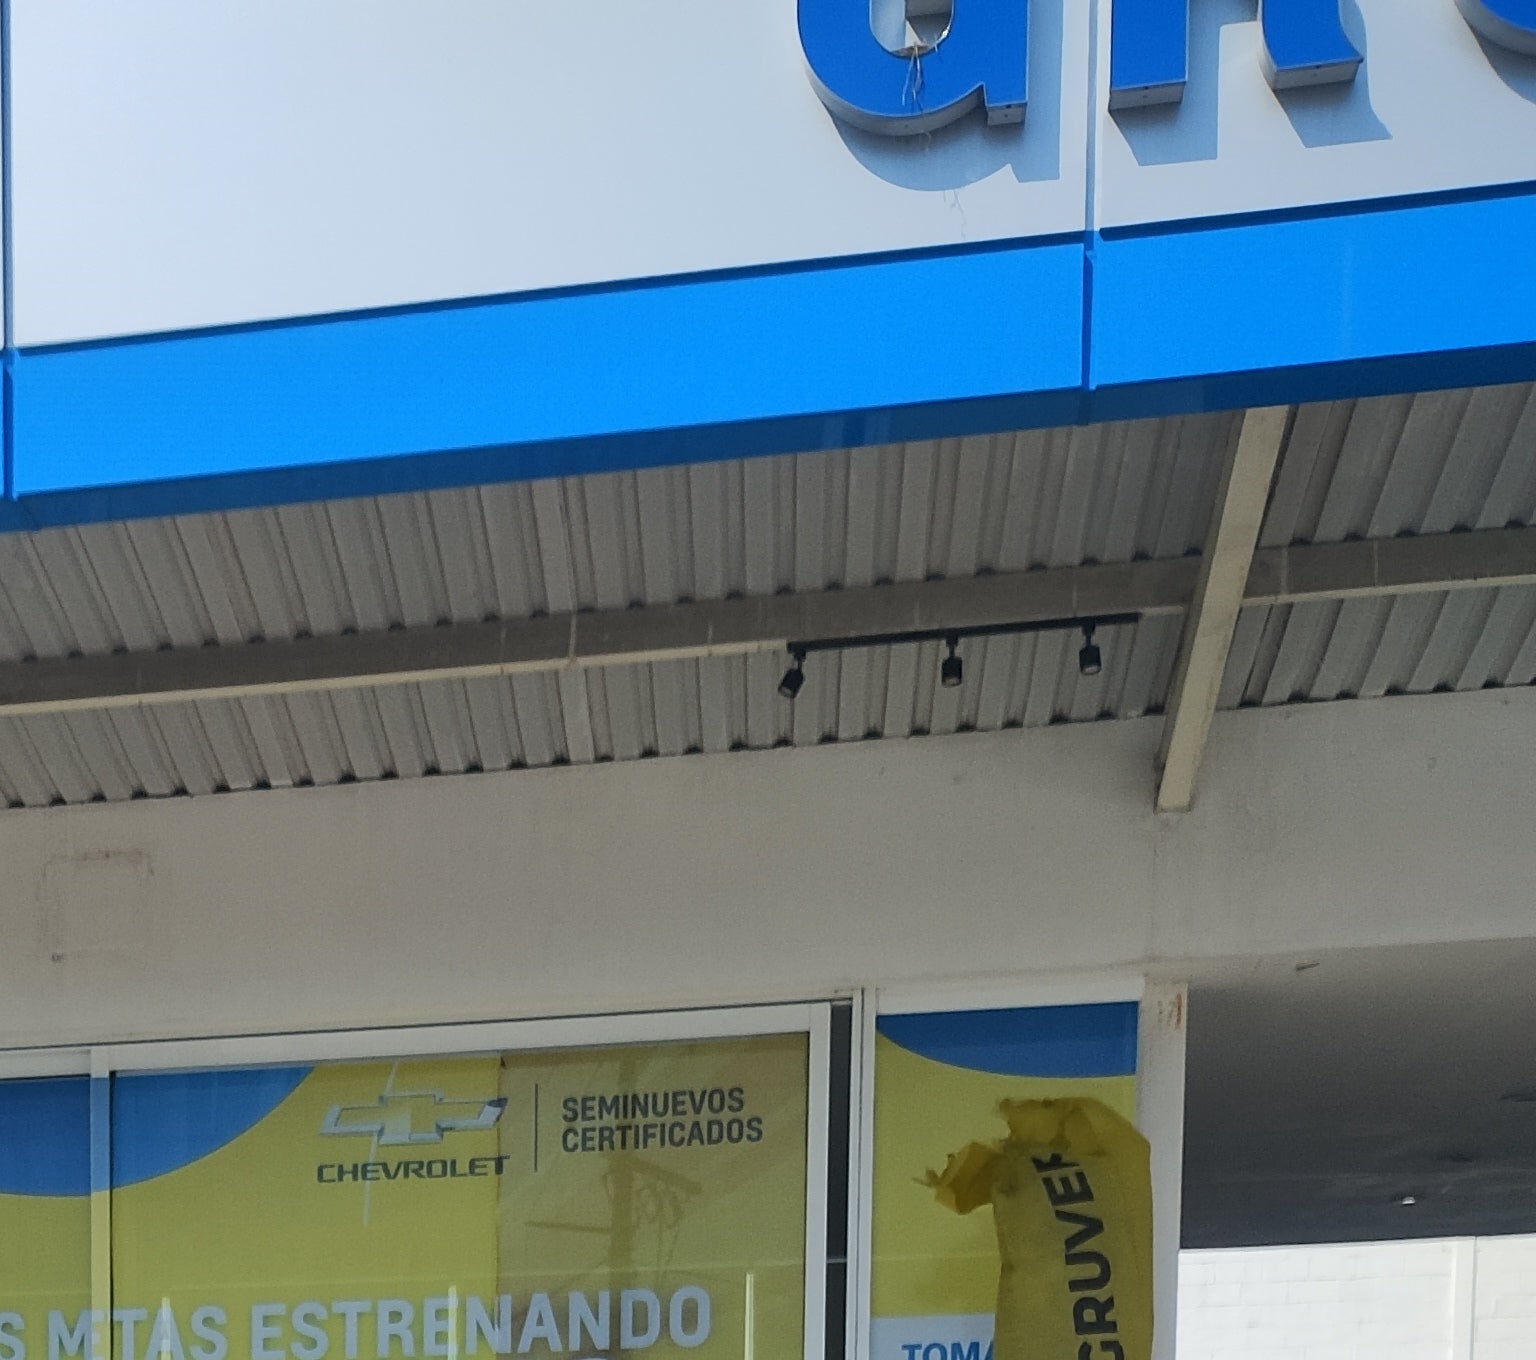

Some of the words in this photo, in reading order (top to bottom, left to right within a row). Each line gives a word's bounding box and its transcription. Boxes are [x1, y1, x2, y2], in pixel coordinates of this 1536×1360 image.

[562, 1087, 744, 1123] SEMINUEVOS
[561, 1116, 764, 1153] CERTIFICADOS
[316, 1155, 510, 1184] CHEVROLET
